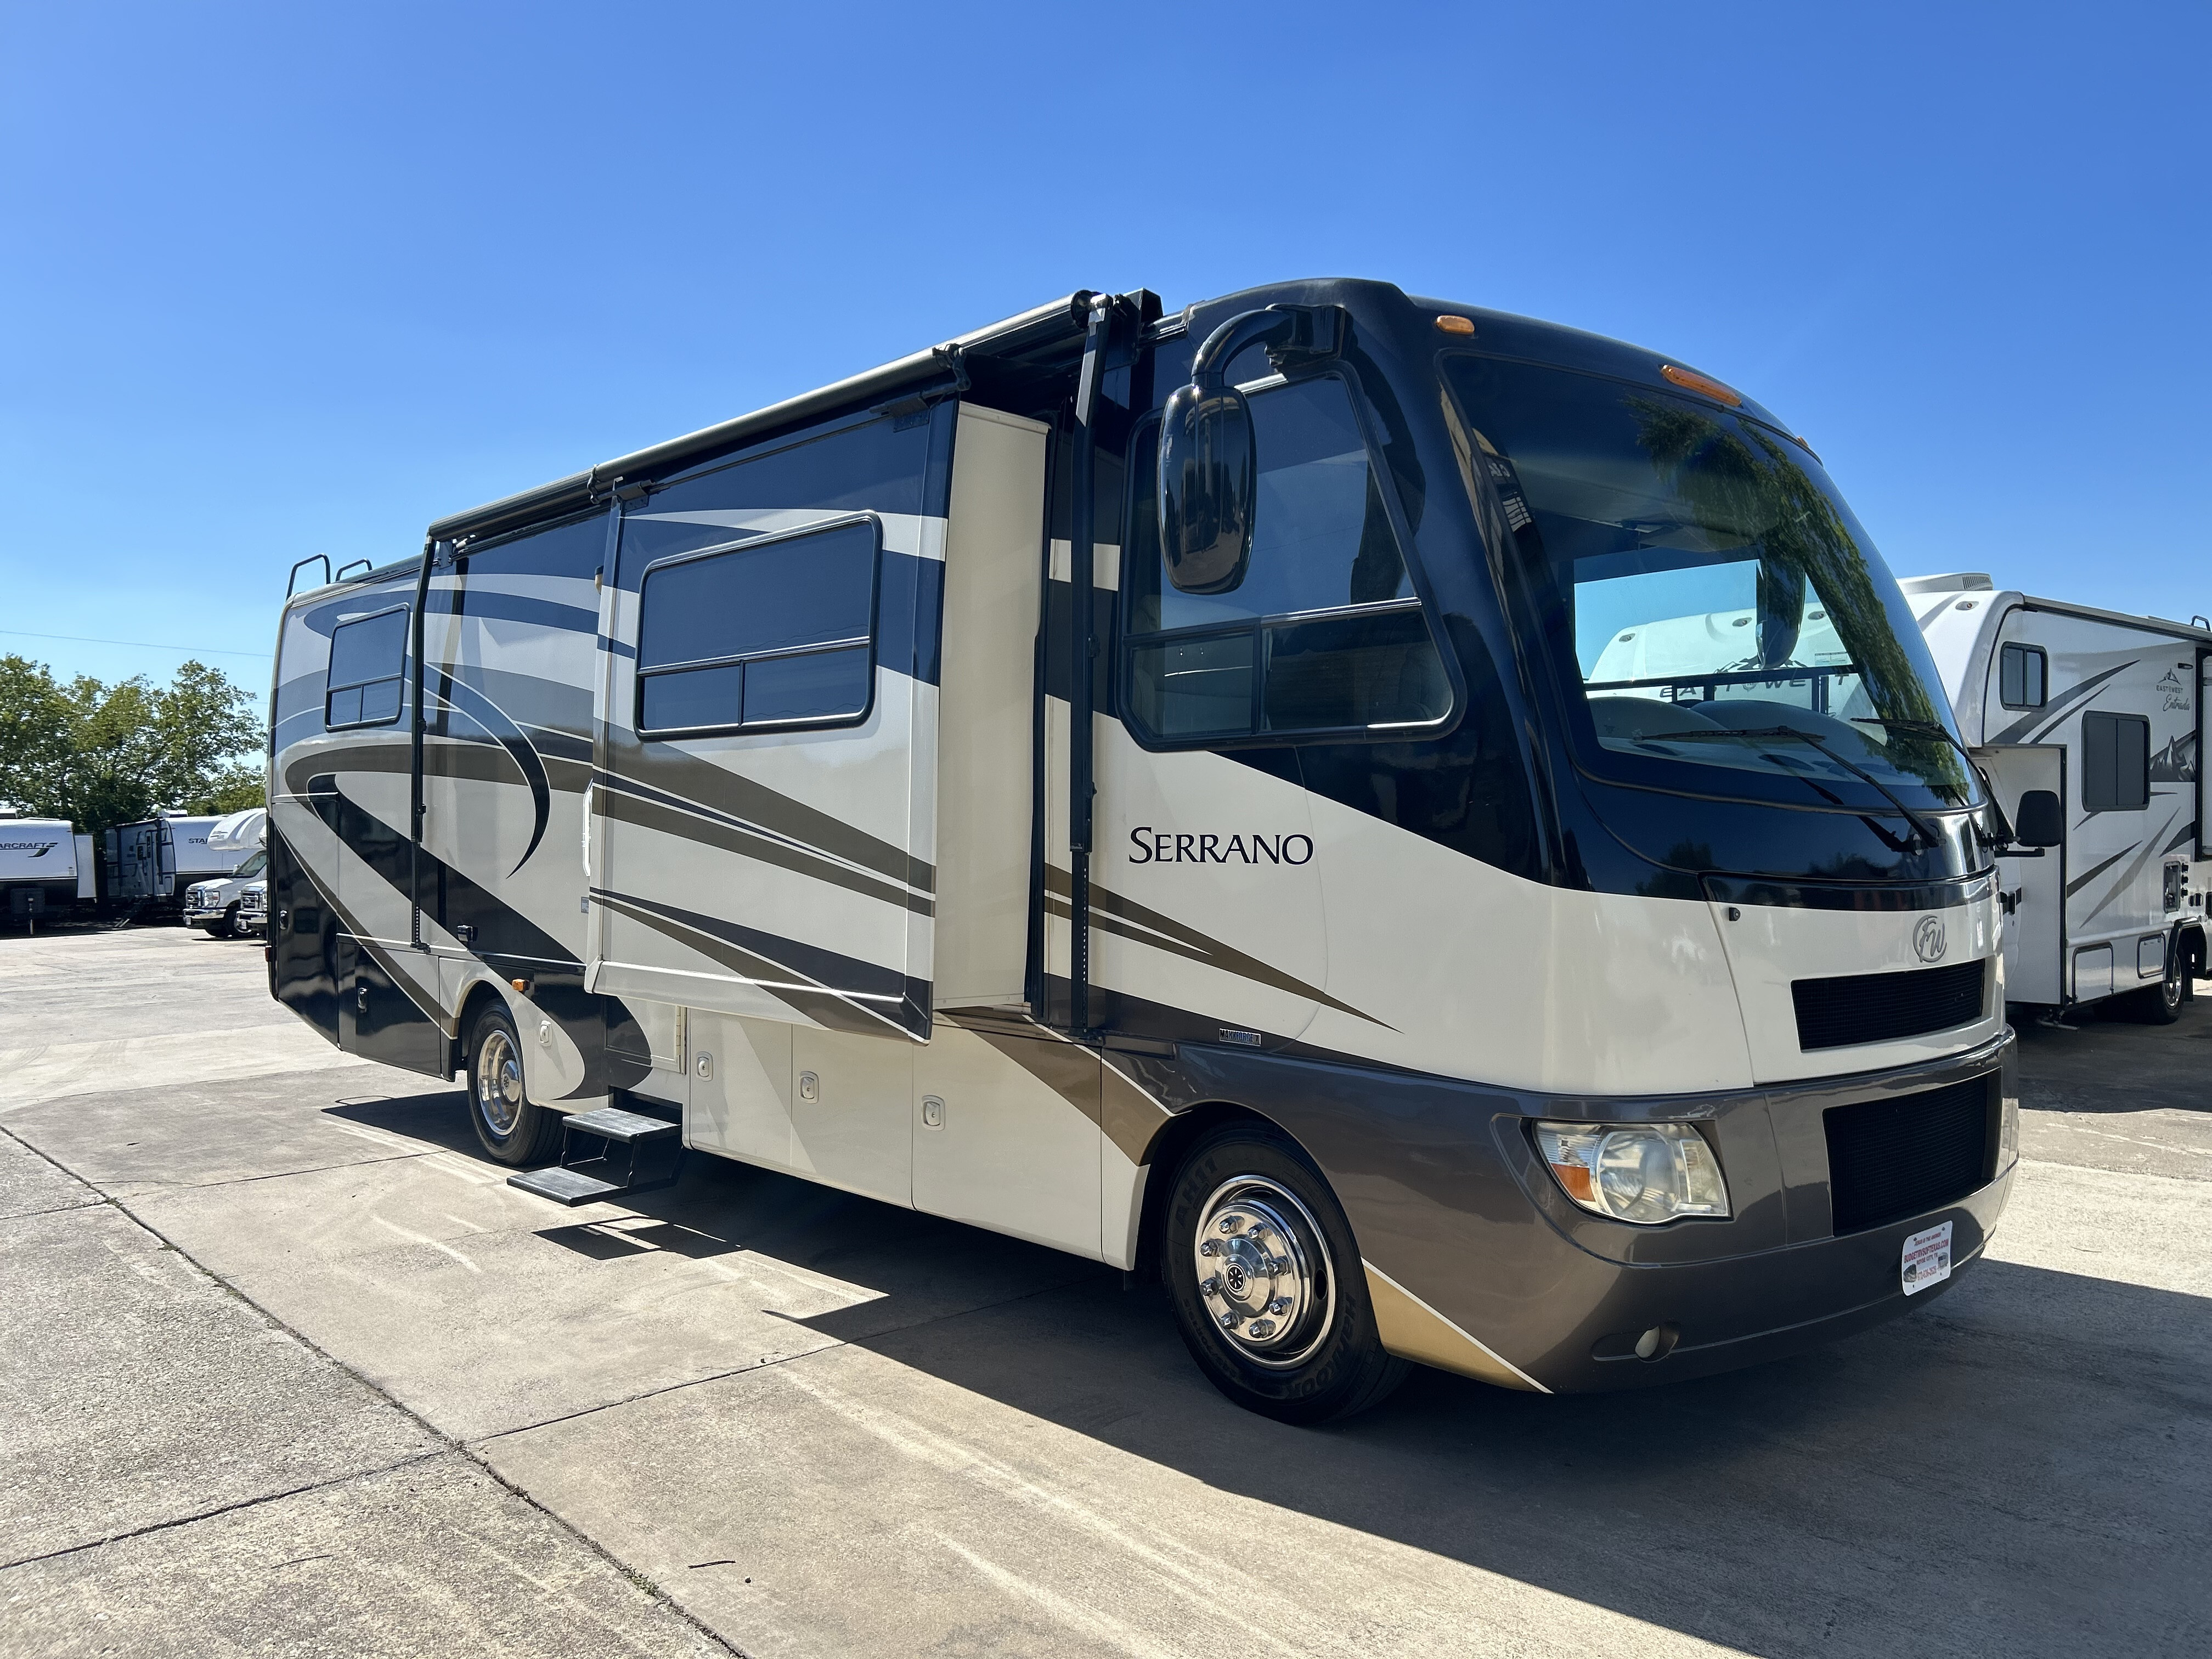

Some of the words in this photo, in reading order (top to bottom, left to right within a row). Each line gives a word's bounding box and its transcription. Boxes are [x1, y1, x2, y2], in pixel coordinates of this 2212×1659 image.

[1765, 674, 1849, 689] WET
[2163, 693, 2191, 712] Entrada
[1128, 826, 1314, 865] SERRANO
